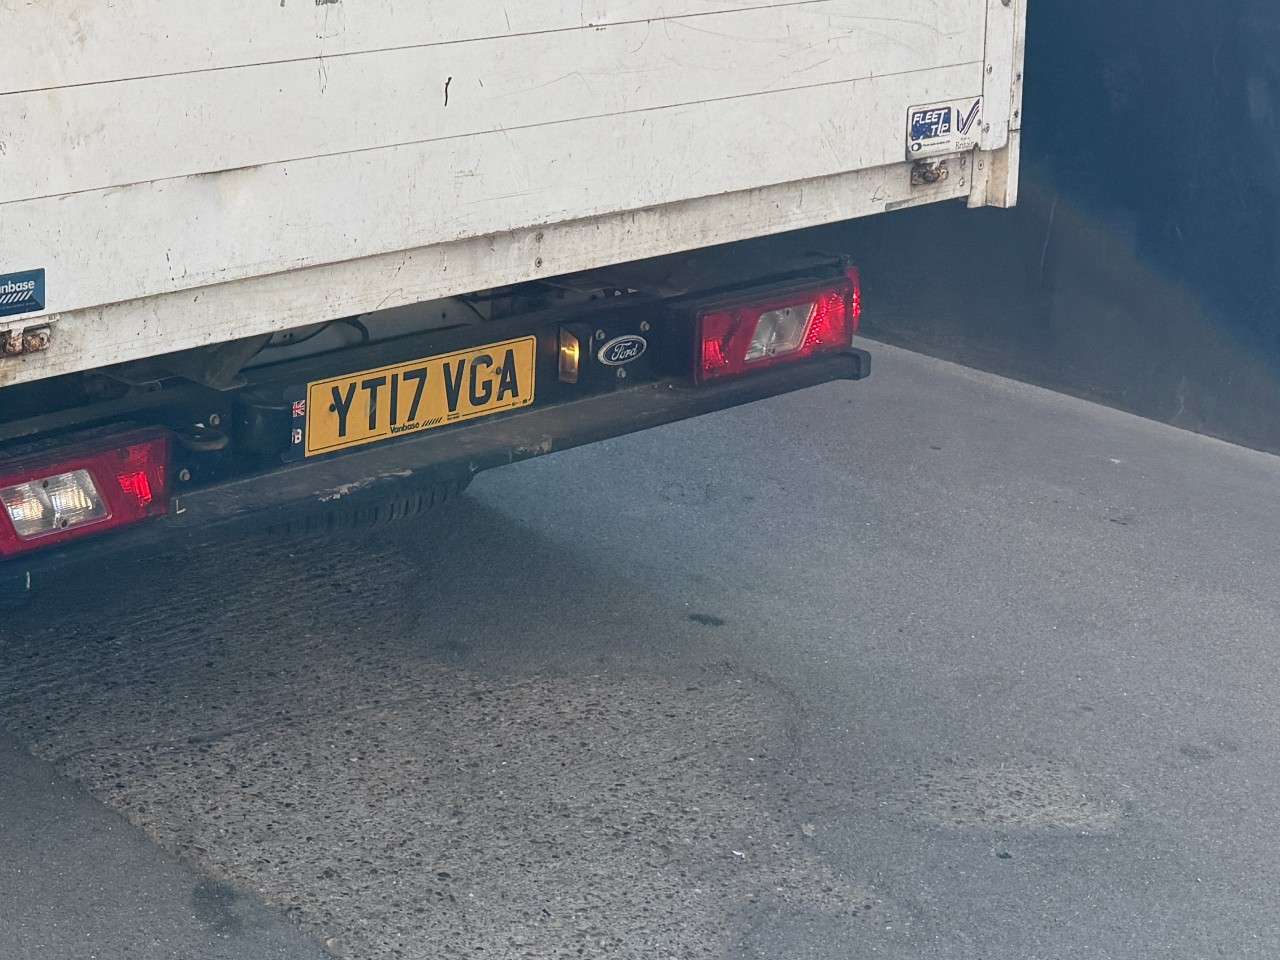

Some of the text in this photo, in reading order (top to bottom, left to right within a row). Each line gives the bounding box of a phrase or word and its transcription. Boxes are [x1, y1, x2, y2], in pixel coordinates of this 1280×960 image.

[912, 109, 948, 125] FLEET
[611, 341, 639, 361] Ford
[331, 349, 519, 438] YT17 VGA
